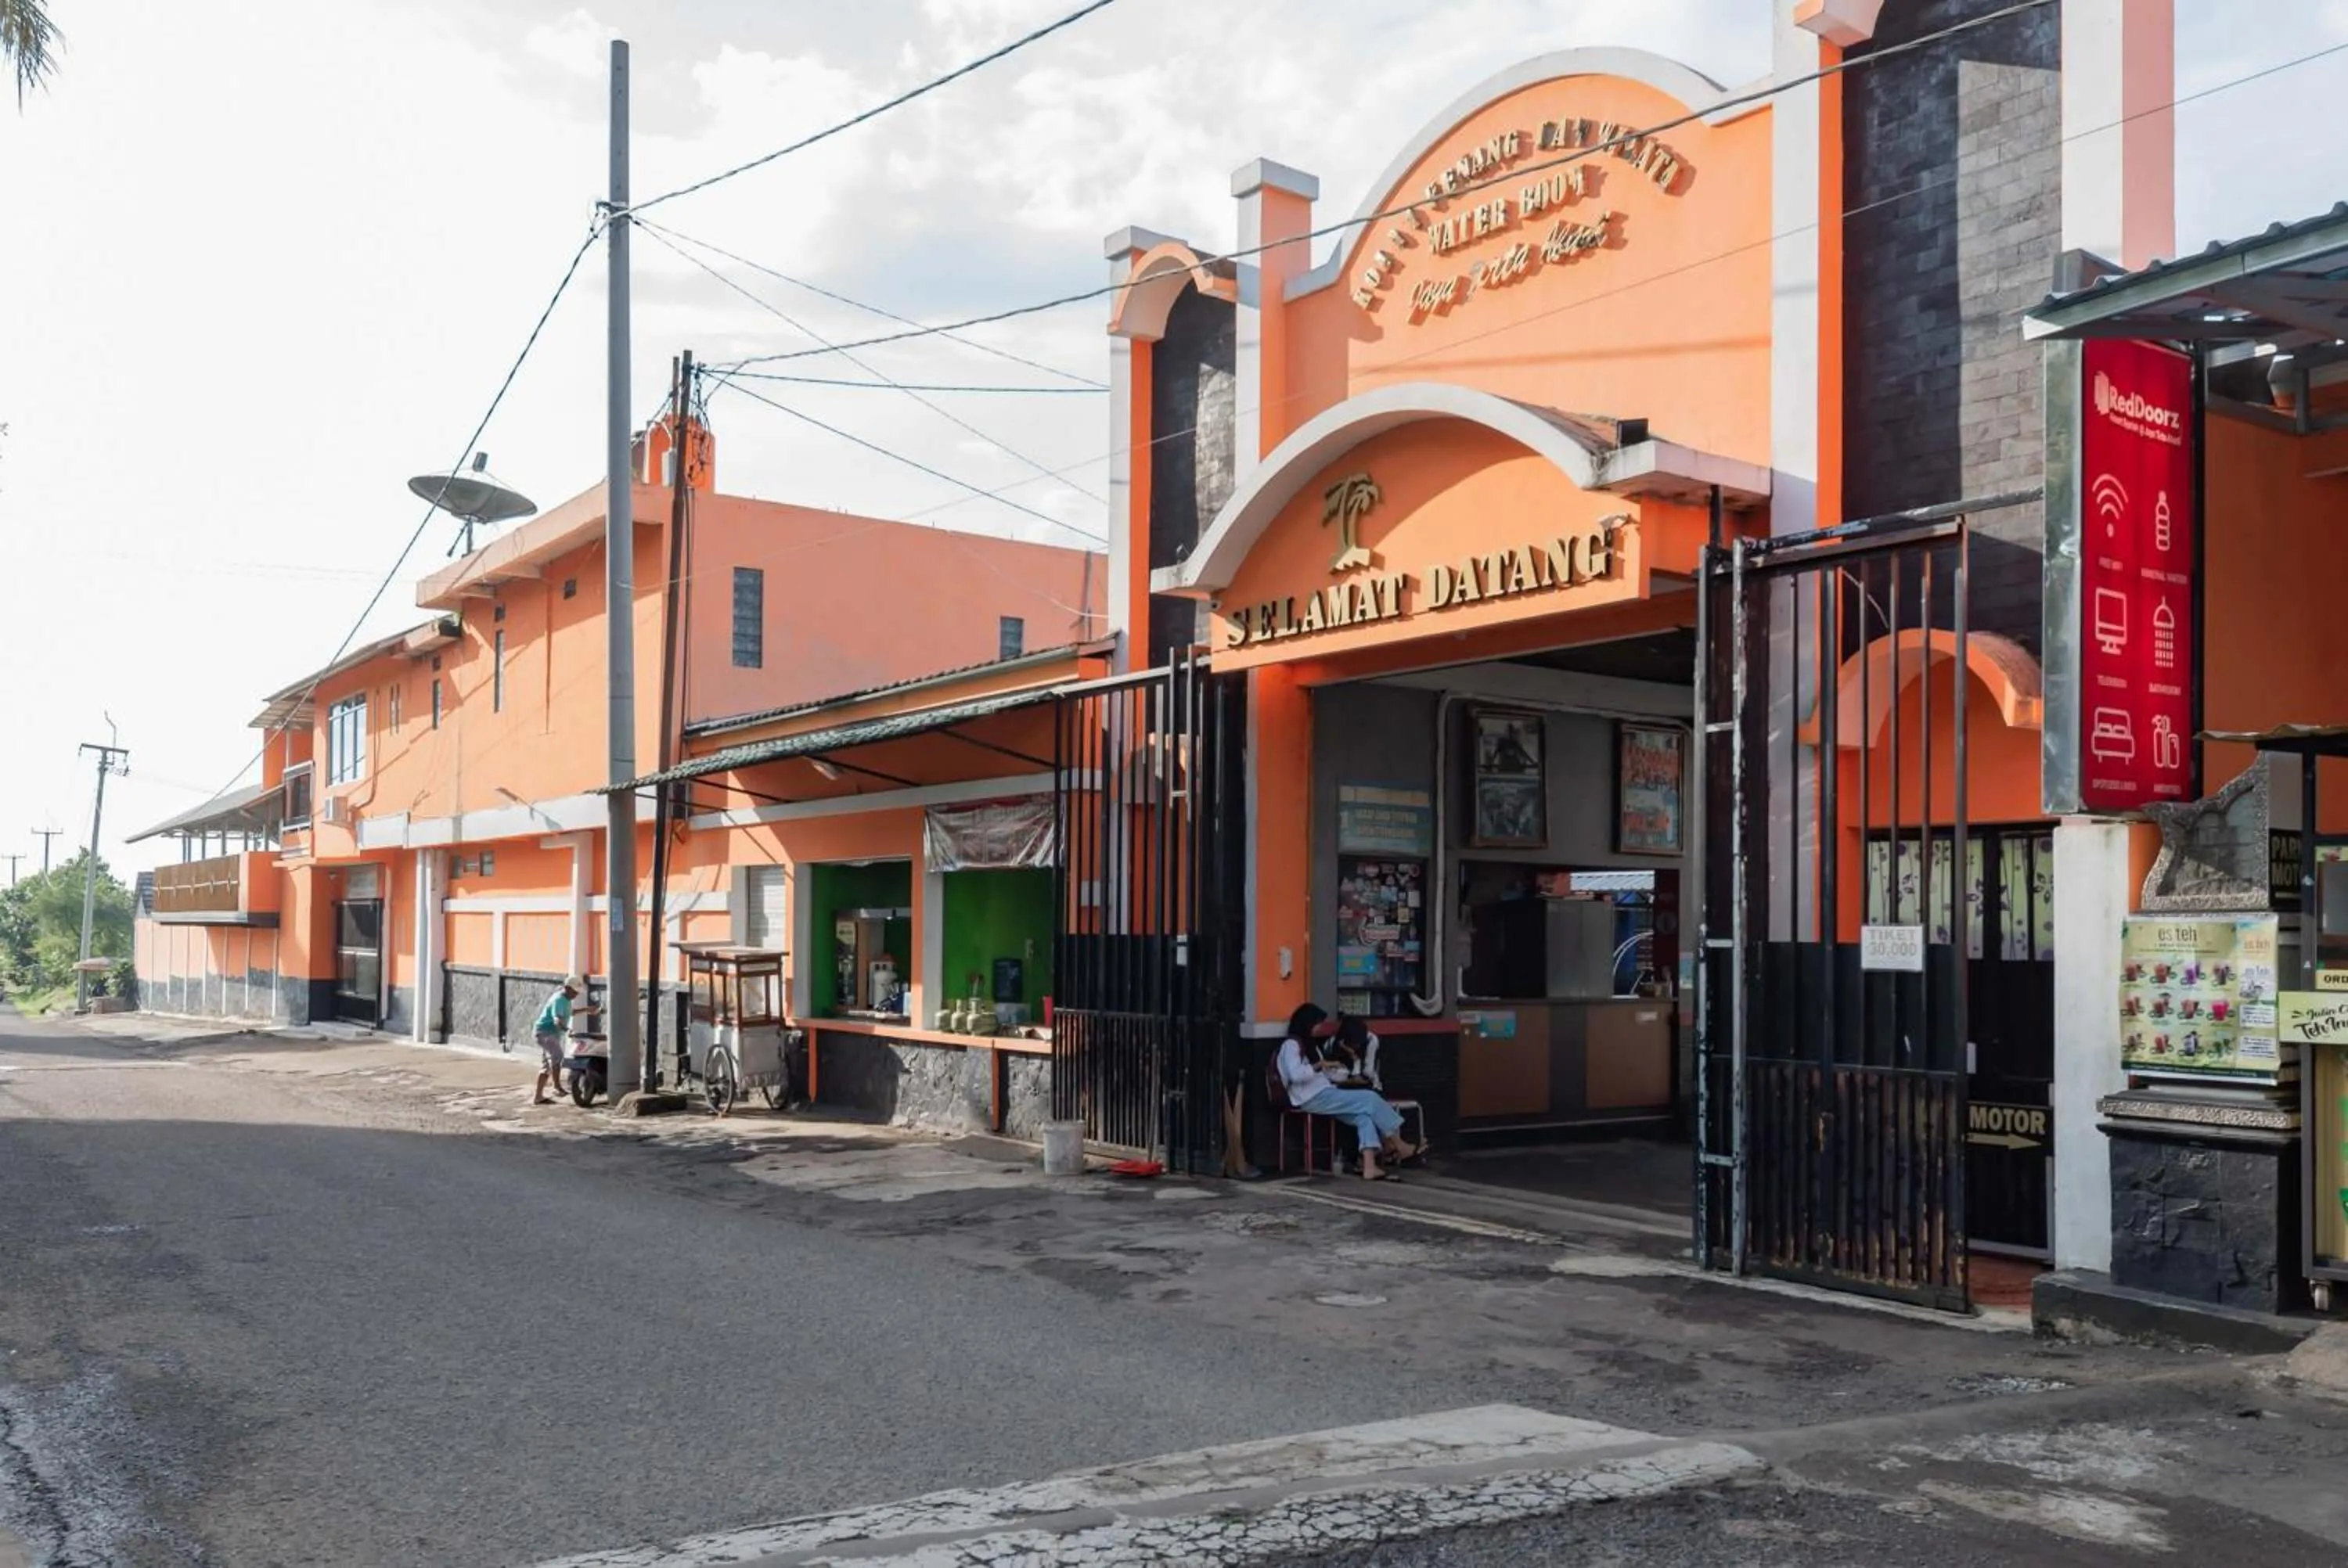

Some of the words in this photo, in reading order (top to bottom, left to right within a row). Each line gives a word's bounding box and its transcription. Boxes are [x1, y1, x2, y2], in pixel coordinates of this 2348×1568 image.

[1424, 130, 1520, 207] RENANG
[1428, 197, 1507, 254] WATER
[1519, 165, 1586, 218] BOOM
[2109, 385, 2180, 429] RedDoorz
[1226, 572, 1406, 646] SELAMAT
[1428, 529, 1613, 611] DATANG
[2271, 861, 2300, 886] MOT
[1867, 929, 1918, 941] TIKET
[2175, 926, 2198, 942] teh
[1968, 1105, 2046, 1135] MOTOR
